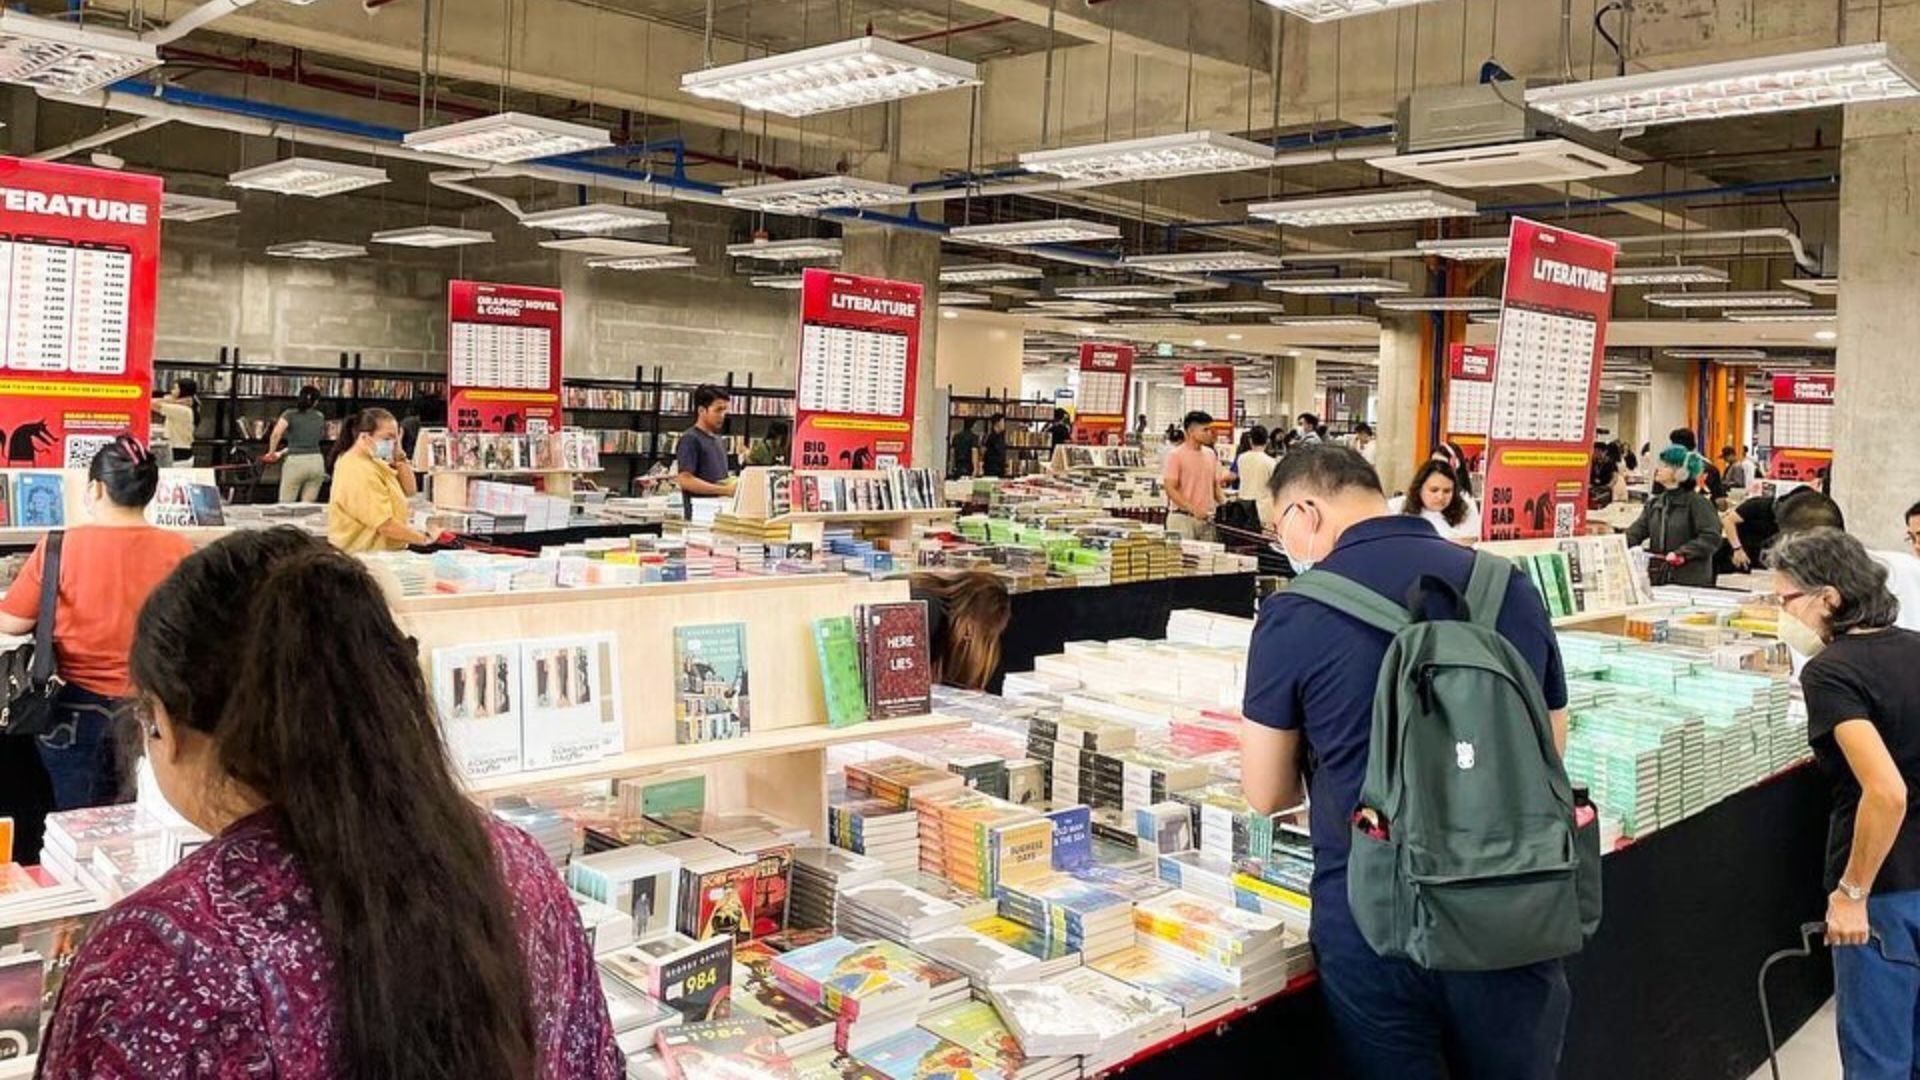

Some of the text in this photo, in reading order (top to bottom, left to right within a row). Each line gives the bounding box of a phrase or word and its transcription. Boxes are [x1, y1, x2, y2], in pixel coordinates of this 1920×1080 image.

[1534, 258, 1608, 293] LITERATURE
[477, 296, 559, 312] GRAPHIC NOVEL
[832, 293, 916, 317] LITERATURE
[476, 305, 520, 317] & COMIC
[459, 419, 482, 428] BAD
[804, 442, 826, 453] BIG
[803, 454, 829, 466] BAD
[1492, 488, 1513, 505] BIG
[1492, 507, 1515, 525] BAD
[888, 635, 916, 649] HERE
[891, 658, 915, 671] LIES
[1056, 826, 1069, 836] OLD
[1070, 824, 1084, 833] MAN
[1061, 835, 1073, 844] THE
[1074, 833, 1085, 842] SEA
[1017, 853, 1036, 863] DAYS
[686, 968, 717, 995] 984
